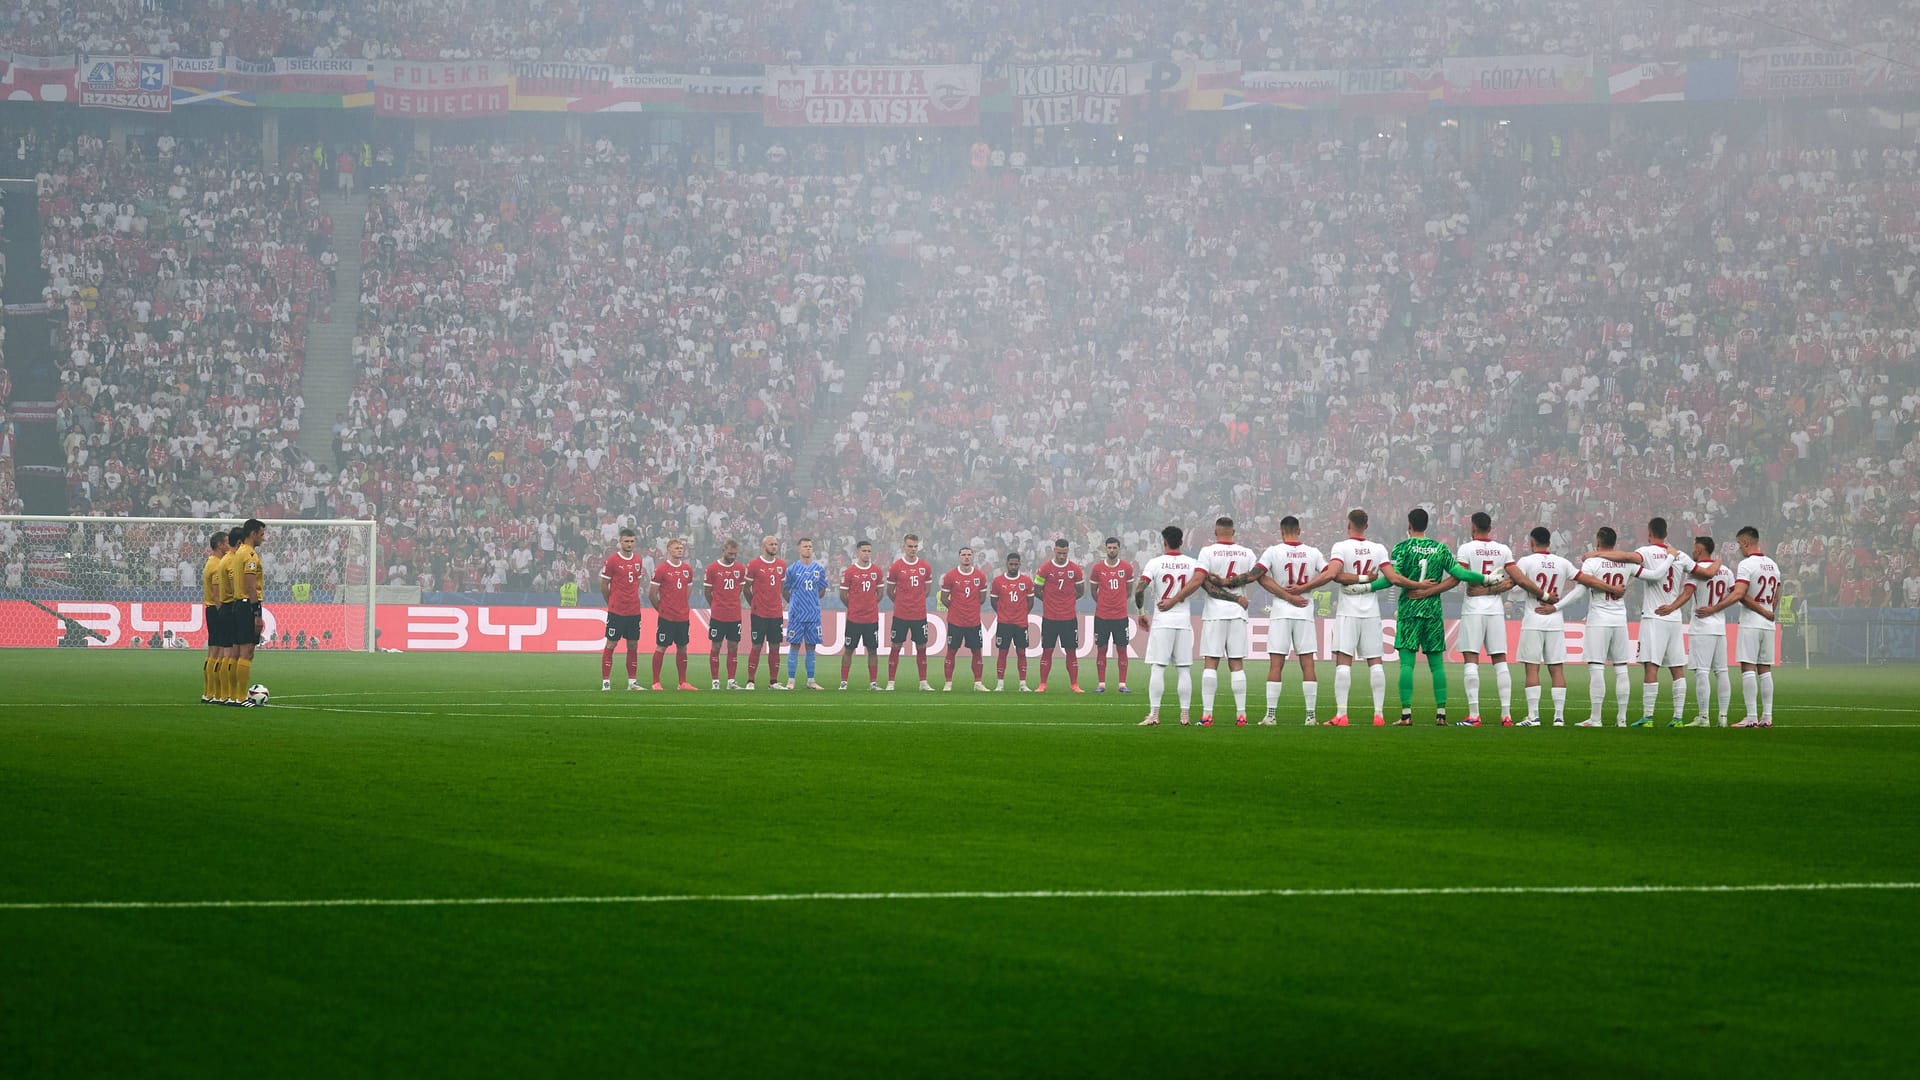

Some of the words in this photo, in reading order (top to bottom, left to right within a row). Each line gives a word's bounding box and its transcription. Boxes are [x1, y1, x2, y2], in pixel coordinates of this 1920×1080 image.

[177, 60, 214, 71] KALISZ
[290, 59, 353, 71] SIEKIERKI
[393, 65, 489, 84] POLSKA
[1016, 63, 1127, 96] KORONA
[622, 76, 682, 86] STOCKHOLM
[812, 69, 928, 95] LECHIA
[1021, 95, 1121, 127] KIELCE
[1161, 562, 1190, 570] ZALEWSKI
[1418, 558, 1428, 582] 1
[1482, 560, 1494, 576] 5
[628, 571, 634, 583] 5
[770, 574, 776, 586] 3
[1284, 562, 1309, 586] 14
[1663, 566, 1674, 593] 3
[676, 578, 682, 589] 6
[723, 578, 734, 590] 20
[804, 579, 813, 591] 13
[861, 580, 871, 592] 19
[909, 575, 919, 587] 15
[1058, 579, 1064, 590] 7
[1108, 578, 1119, 590] 10
[1536, 572, 1559, 594] 24
[1602, 572, 1624, 601] 10
[964, 587, 971, 598] 9
[1162, 573, 1187, 602] 21
[1707, 580, 1726, 607] 19
[1754, 575, 1777, 605] 23
[1008, 591, 1019, 602] 16
[407, 606, 609, 651] BYD
